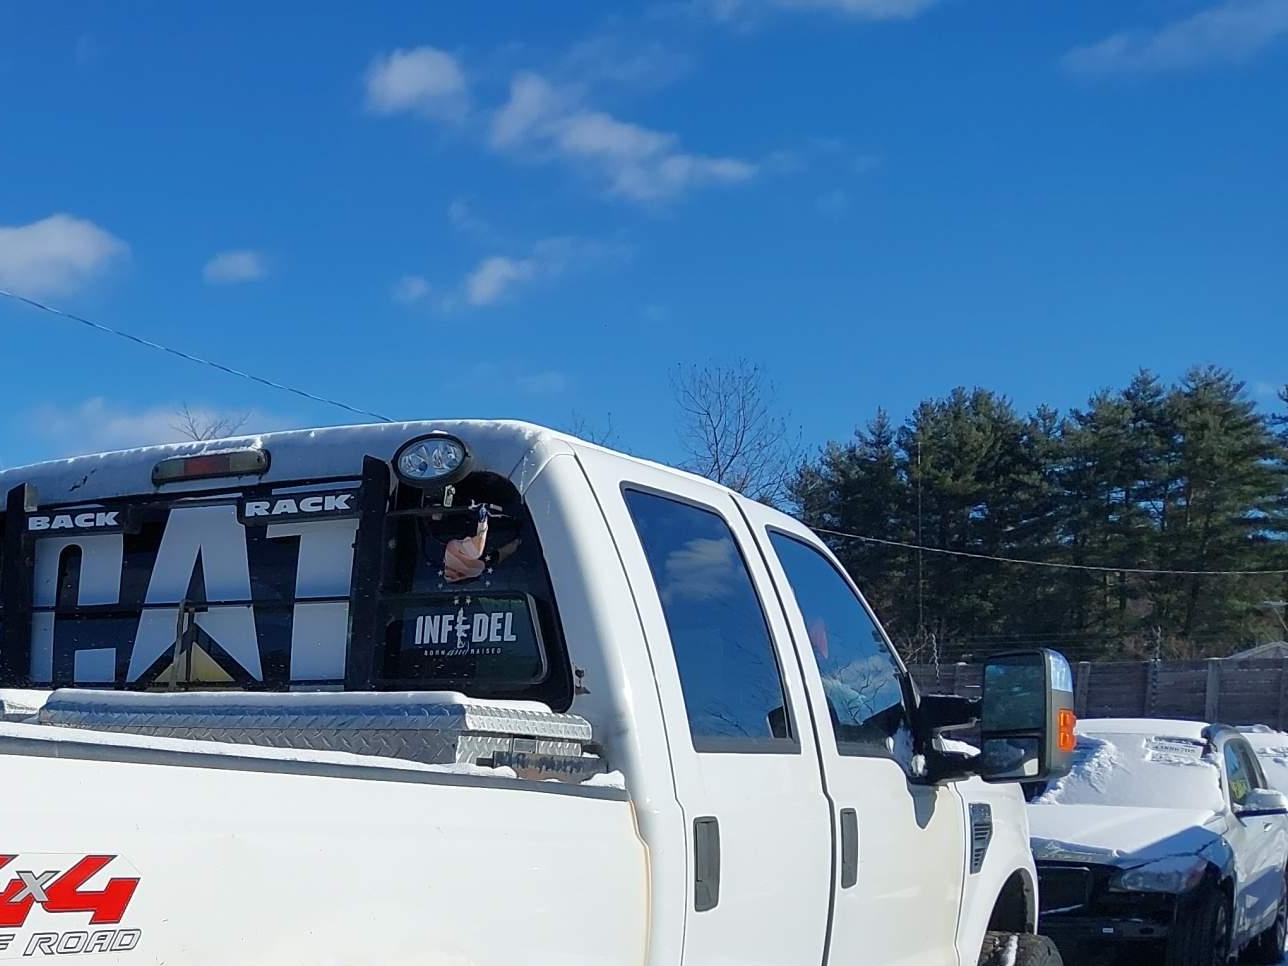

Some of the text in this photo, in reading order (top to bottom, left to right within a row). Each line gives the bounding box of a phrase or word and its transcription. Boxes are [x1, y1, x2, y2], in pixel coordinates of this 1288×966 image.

[27, 494, 354, 531] BACK RACK
[23, 928, 142, 956] ROAD
